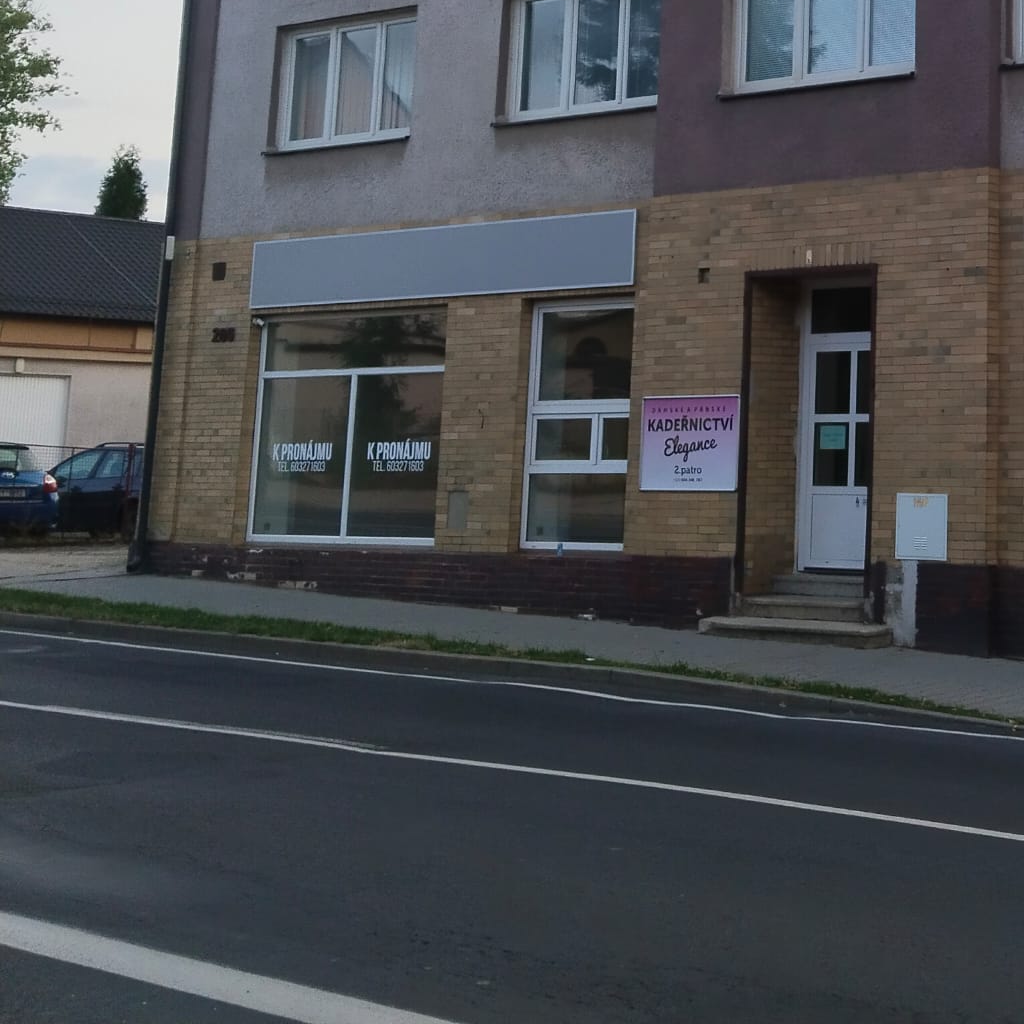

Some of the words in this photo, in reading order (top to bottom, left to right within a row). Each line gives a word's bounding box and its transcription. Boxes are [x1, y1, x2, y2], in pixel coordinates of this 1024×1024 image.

[647, 414, 734, 432] KADEŘNICTVÍ
[272, 442, 279, 461] K
[281, 439, 333, 461] PRONÁJMU
[367, 442, 374, 460] K
[376, 438, 431, 460] PRONÁJMU
[664, 435, 718, 463] Elegance
[278, 461, 288, 472] TEL.
[372, 460, 385, 471] TEL.
